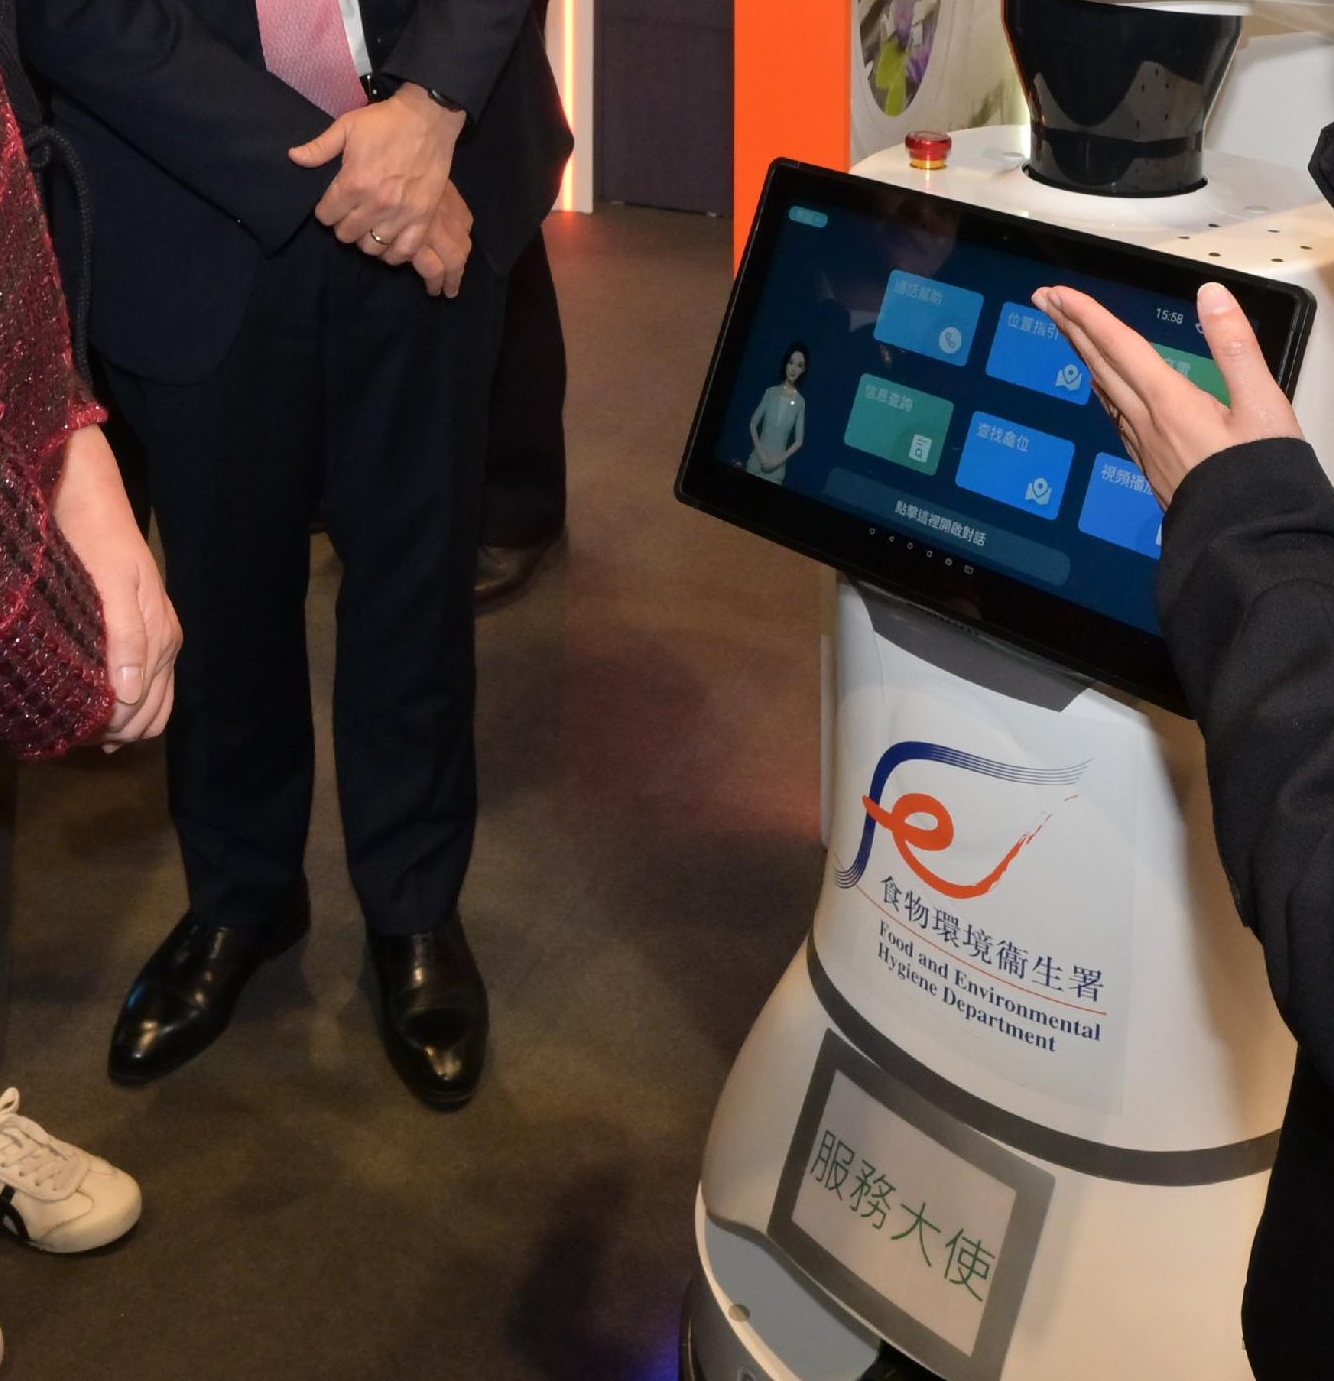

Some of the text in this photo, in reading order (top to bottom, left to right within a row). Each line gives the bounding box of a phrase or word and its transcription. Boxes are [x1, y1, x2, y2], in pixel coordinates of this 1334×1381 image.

[1155, 307, 1184, 325] 15:58
[878, 942, 1056, 1052] Hygiene Department
[879, 919, 1101, 1042] Food and Environmental
[810, 1129, 996, 1302] 服務大使
